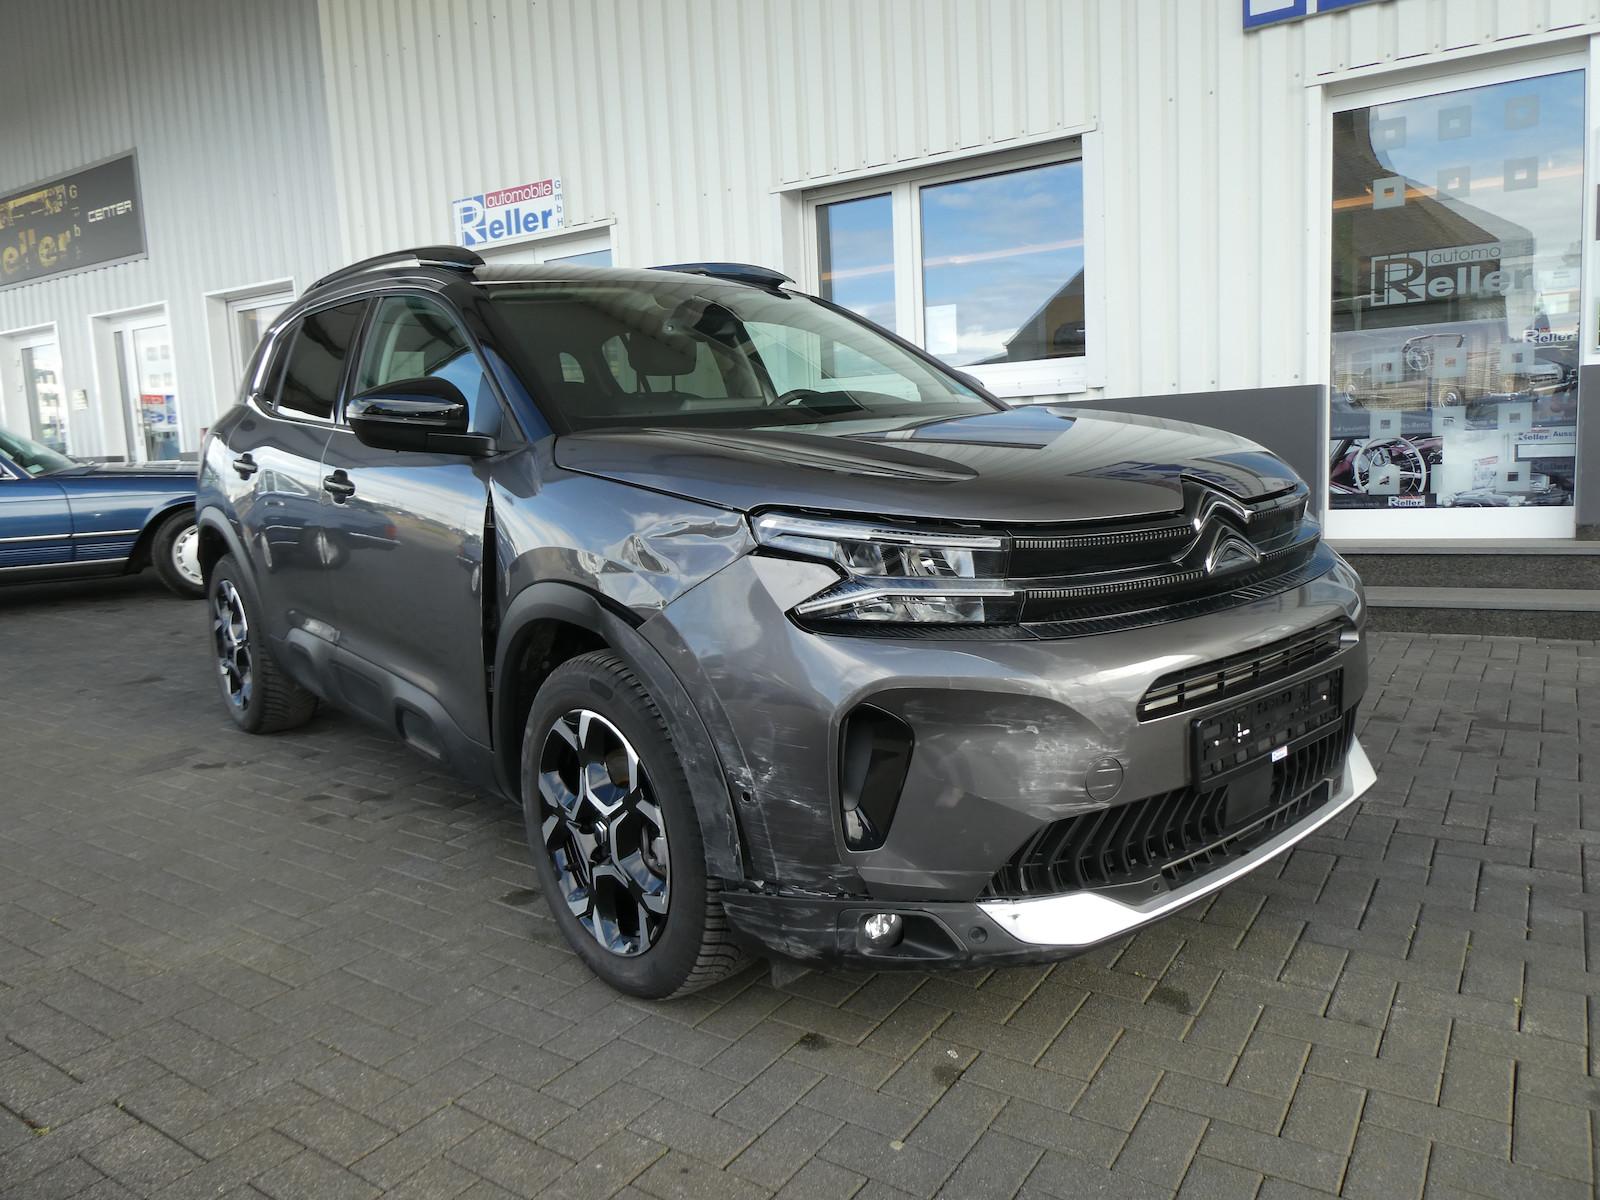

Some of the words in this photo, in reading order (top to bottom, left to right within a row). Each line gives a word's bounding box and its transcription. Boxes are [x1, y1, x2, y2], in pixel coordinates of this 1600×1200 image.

[487, 182, 552, 208] automobile
[88, 200, 132, 223] CENTER
[452, 197, 553, 247] Reller
[1430, 246, 1501, 265] automo
[1371, 251, 1533, 307] Reller
